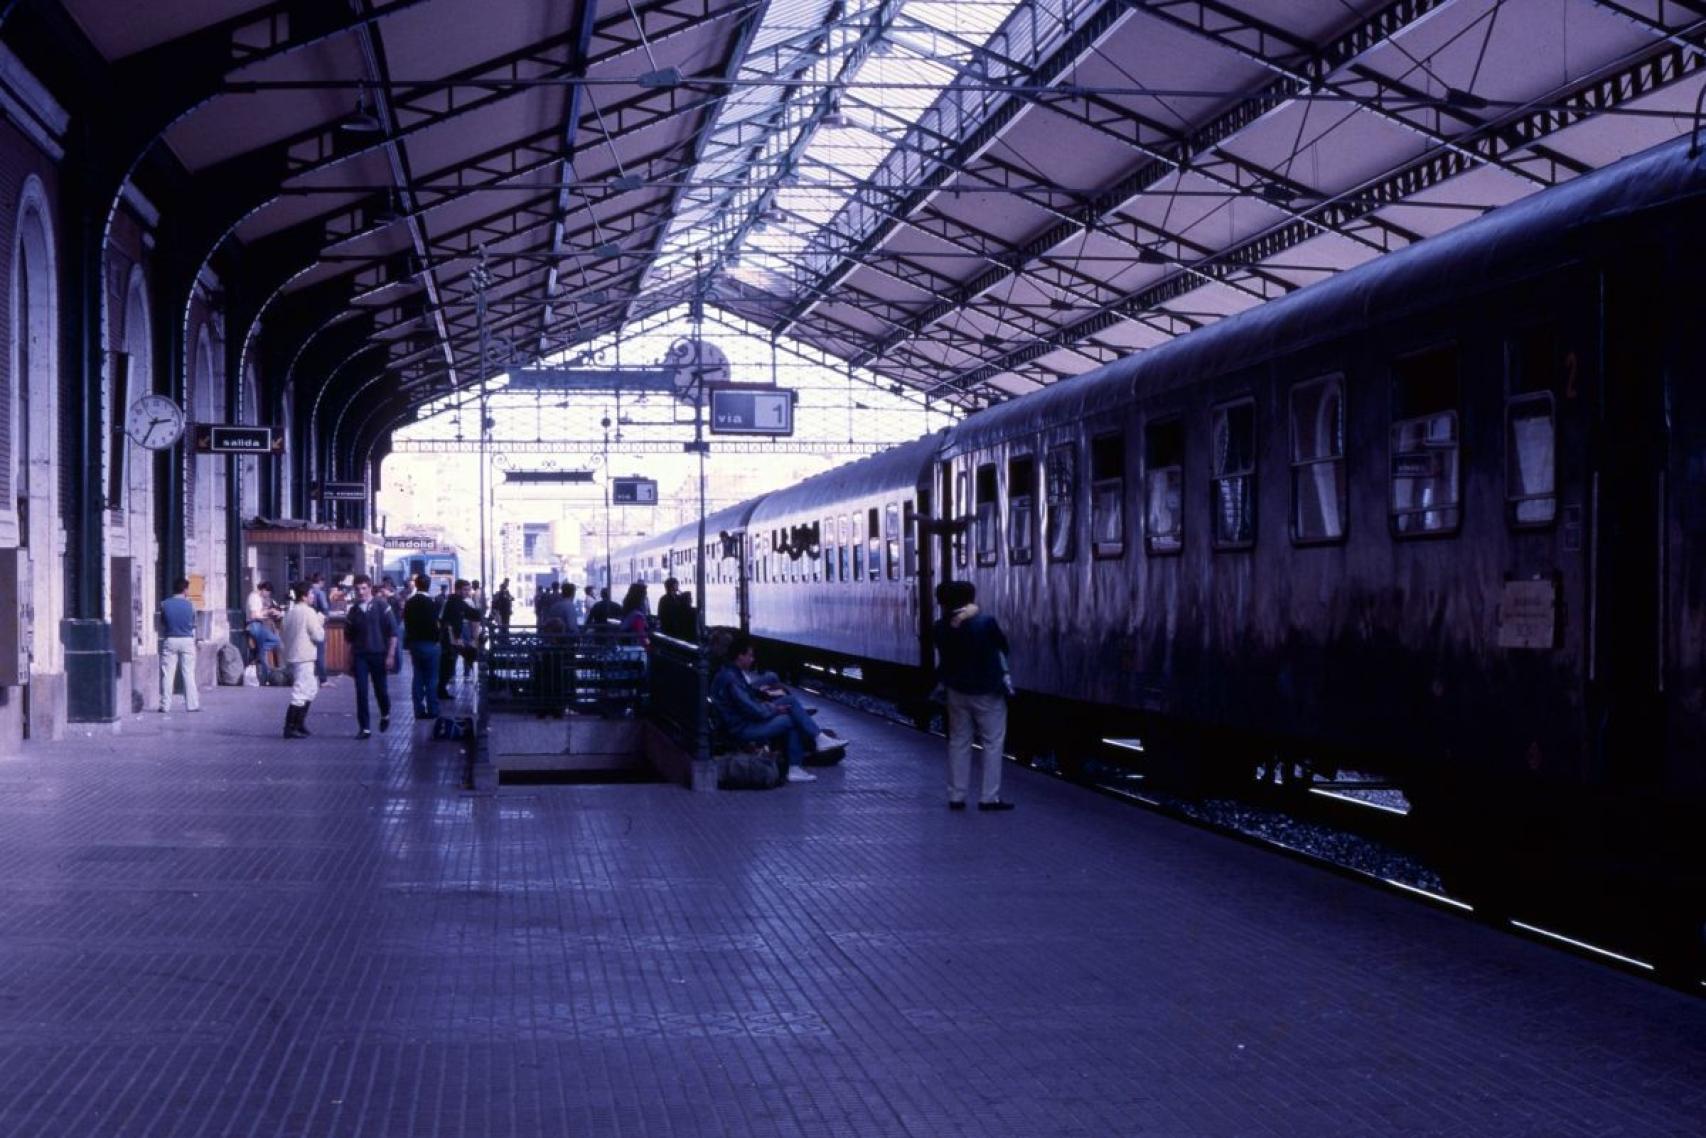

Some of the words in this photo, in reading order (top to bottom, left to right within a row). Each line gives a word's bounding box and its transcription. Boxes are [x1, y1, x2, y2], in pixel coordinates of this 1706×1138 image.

[1566, 352, 1577, 399] 2
[773, 404, 783, 425] 1
[223, 438, 260, 447] salida
[647, 488, 653, 499] 1
